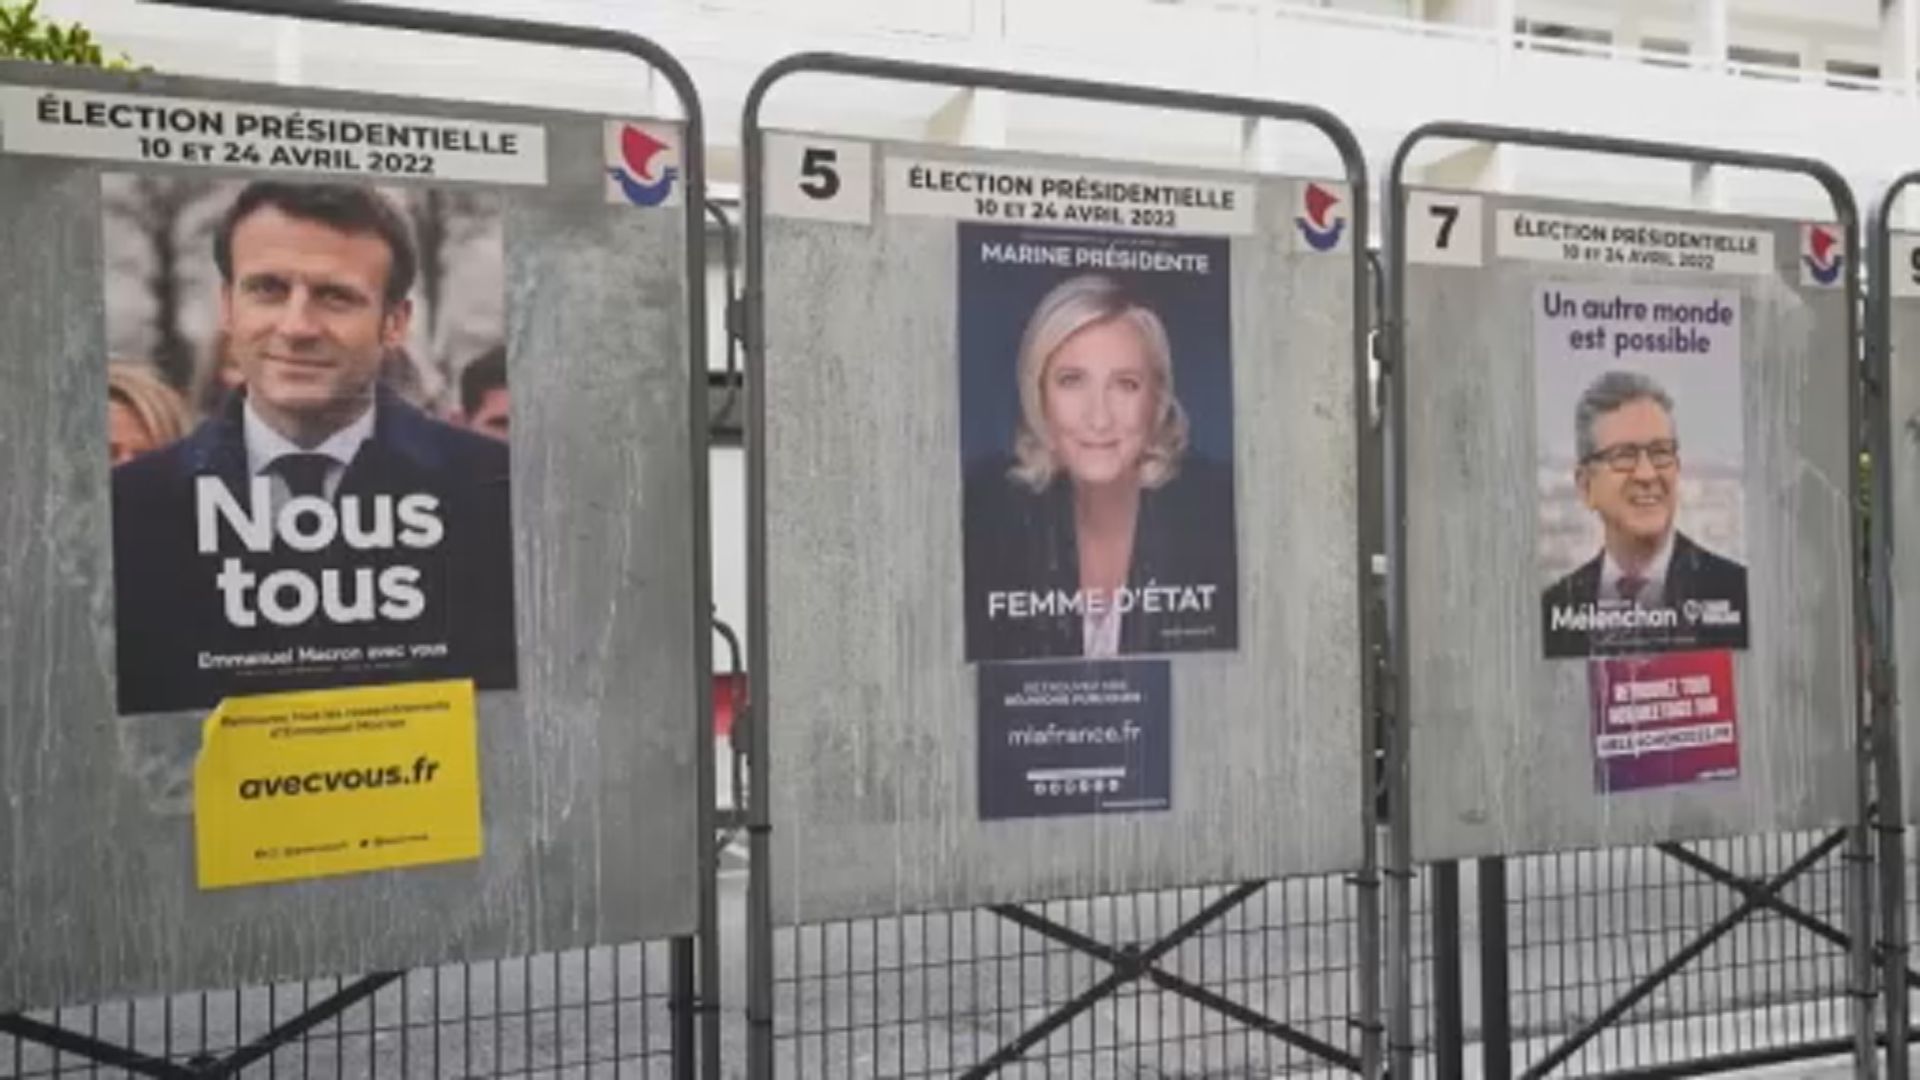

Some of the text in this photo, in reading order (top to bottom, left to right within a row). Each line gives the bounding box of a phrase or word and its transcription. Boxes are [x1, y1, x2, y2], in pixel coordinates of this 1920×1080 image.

[37, 93, 518, 155] ÉLECTION PRÉSIDENTIELLE
[138, 137, 435, 174] 10 ET 24 AVRIL 2022
[799, 147, 840, 200] 5
[909, 166, 1234, 210] ÉLECTION PRÉSIDENTIELLE
[975, 198, 1176, 228] 10 ET 24 AVRIL 2022
[1429, 206, 1459, 249] 7
[1514, 213, 1757, 255] ÉLECTION PRÉSIDENTIELLE
[981, 242, 1210, 274] MARINE PRÉSIDENTE
[1563, 243, 1579, 260] 10
[1628, 249, 1675, 267] AVRIL
[1544, 291, 1733, 325] Un autre monde
[1570, 326, 1711, 358] est possible
[196, 475, 444, 553] Nous
[216, 558, 427, 627] tous
[988, 578, 1217, 618] FEMME D'ÉTAT
[1552, 602, 1677, 631] Mélenchon
[198, 648, 292, 670] Emmanuel
[298, 645, 364, 662] Macron
[367, 645, 405, 660] avec
[409, 643, 448, 658] vous
[239, 755, 440, 801] avecvous.fr
